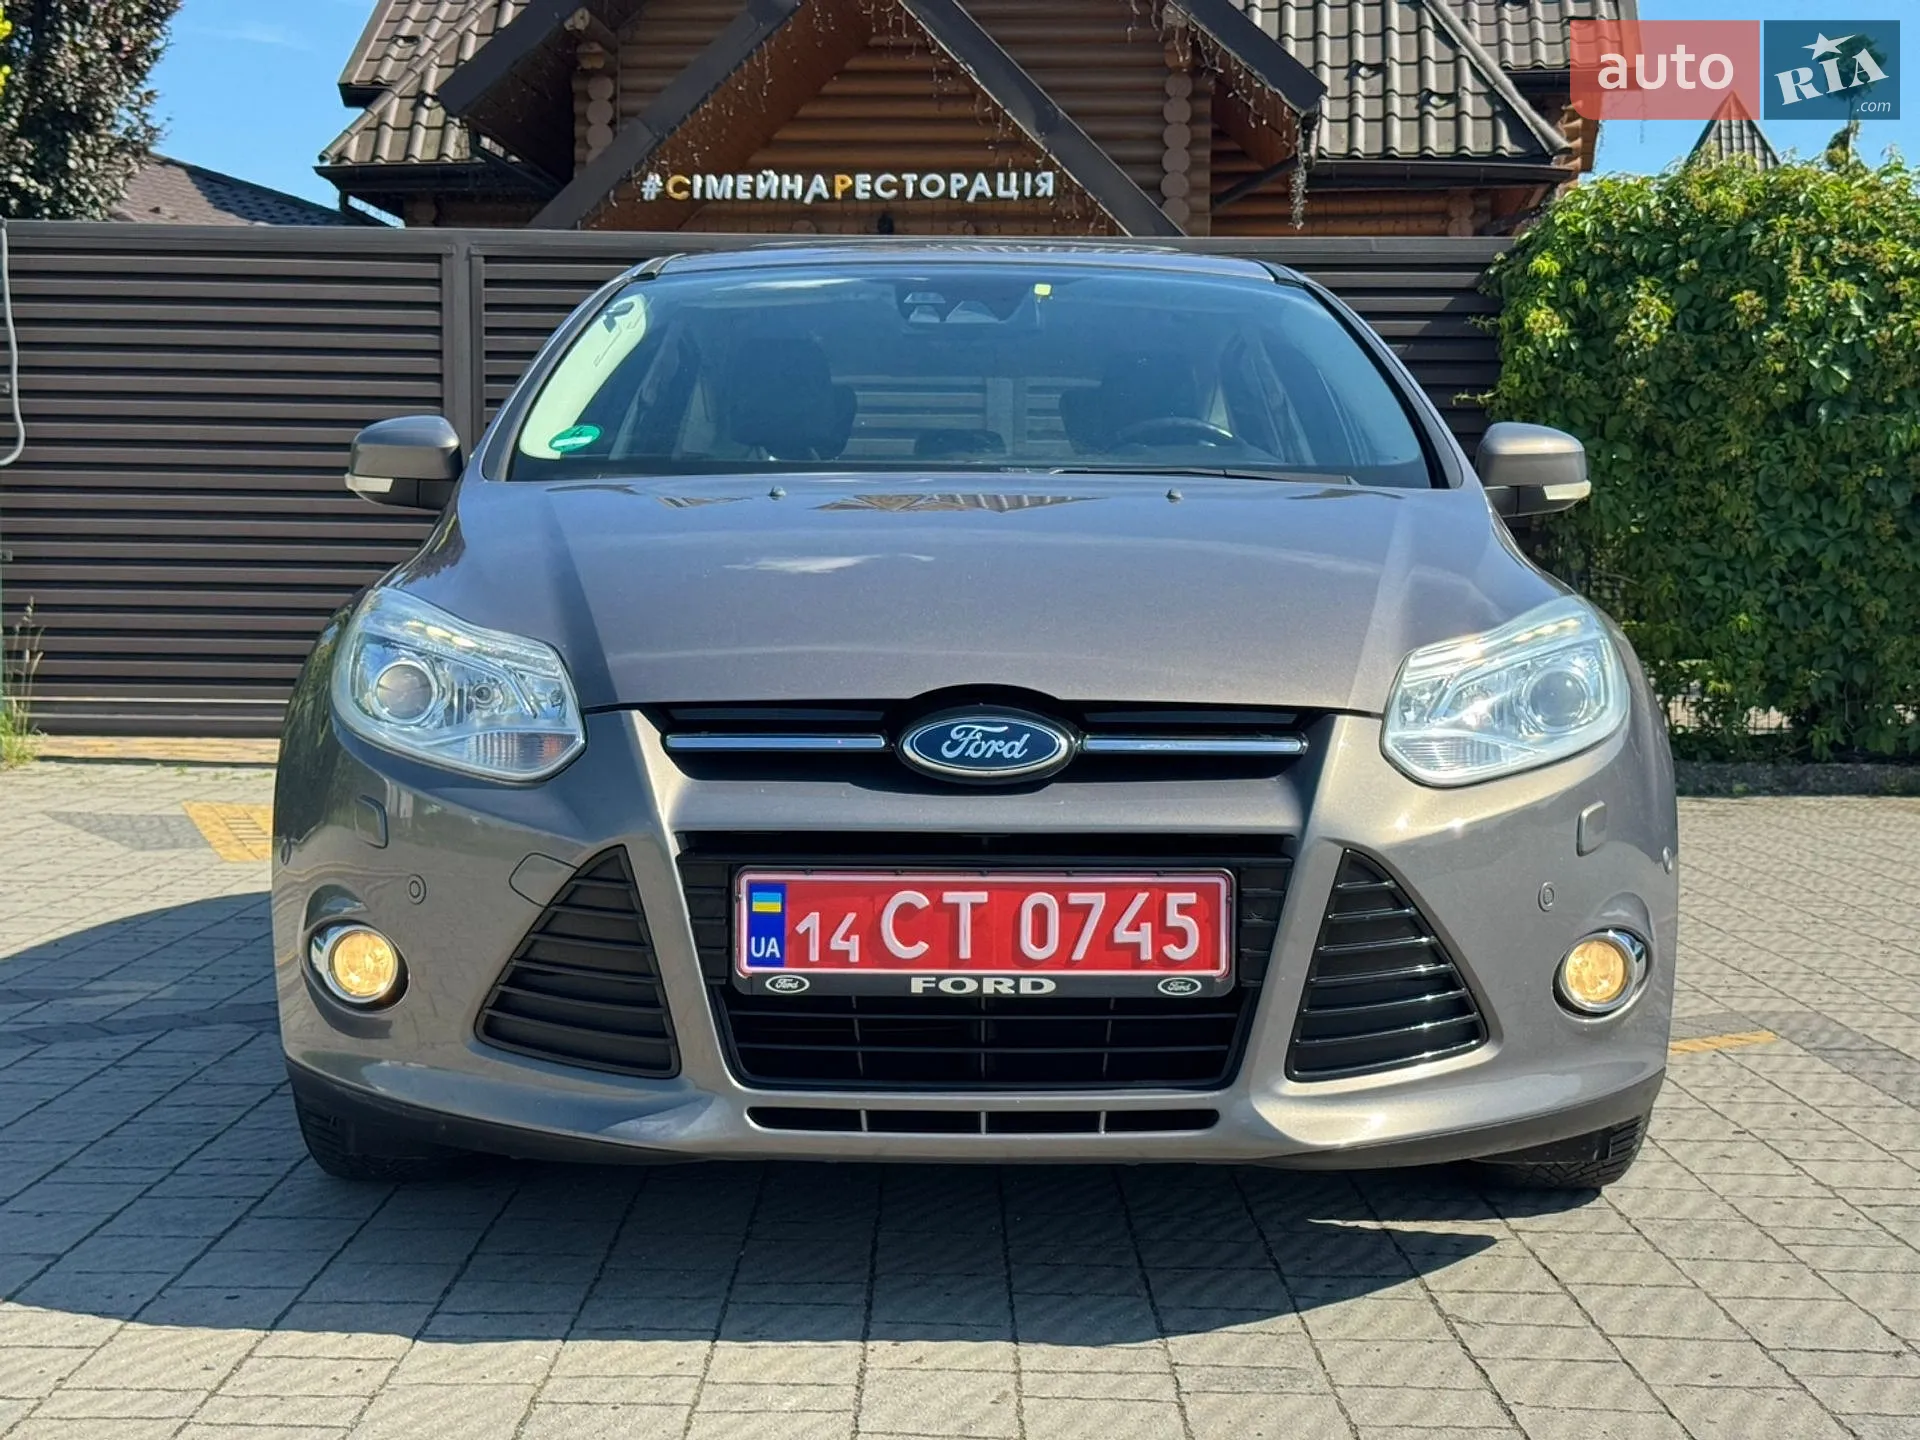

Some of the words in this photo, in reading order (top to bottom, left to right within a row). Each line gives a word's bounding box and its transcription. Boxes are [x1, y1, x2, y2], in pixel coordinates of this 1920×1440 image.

[641, 169, 1055, 204] #СІМЕЙНАРЕСТОРАЦІЯ
[941, 724, 1031, 759] Ford
[795, 911, 860, 963] 14
[880, 890, 989, 961] CT
[1019, 891, 1200, 962] 0745
[750, 936, 782, 960] UA
[910, 976, 1057, 995] FORD
